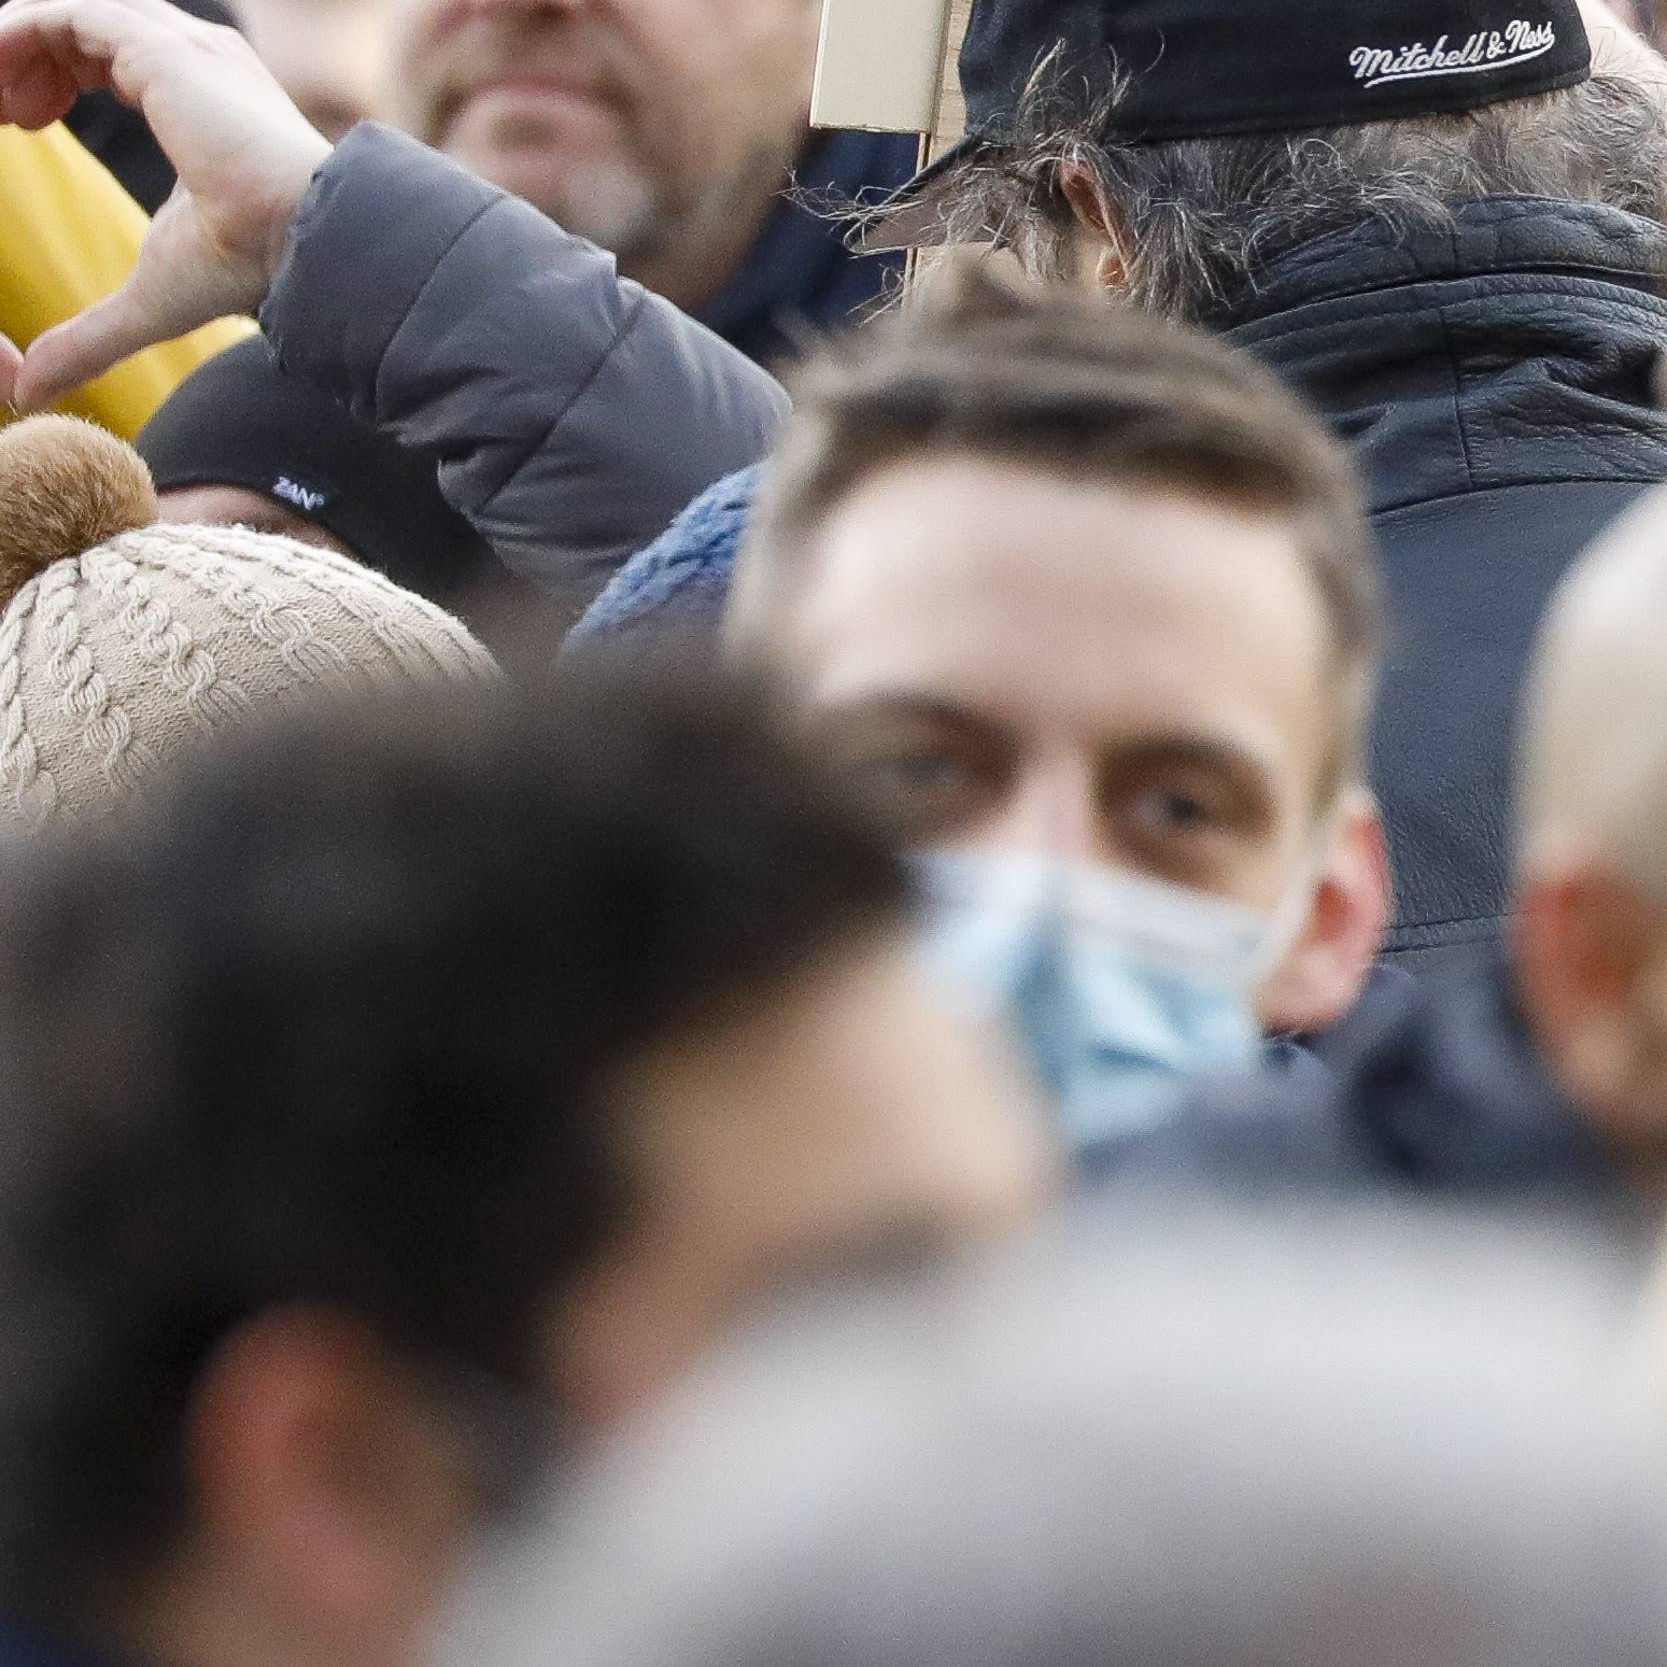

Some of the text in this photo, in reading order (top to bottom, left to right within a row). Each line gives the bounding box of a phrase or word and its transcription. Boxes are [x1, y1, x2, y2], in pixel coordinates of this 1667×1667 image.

[1350, 19, 1556, 79] Mitchell & Ness
